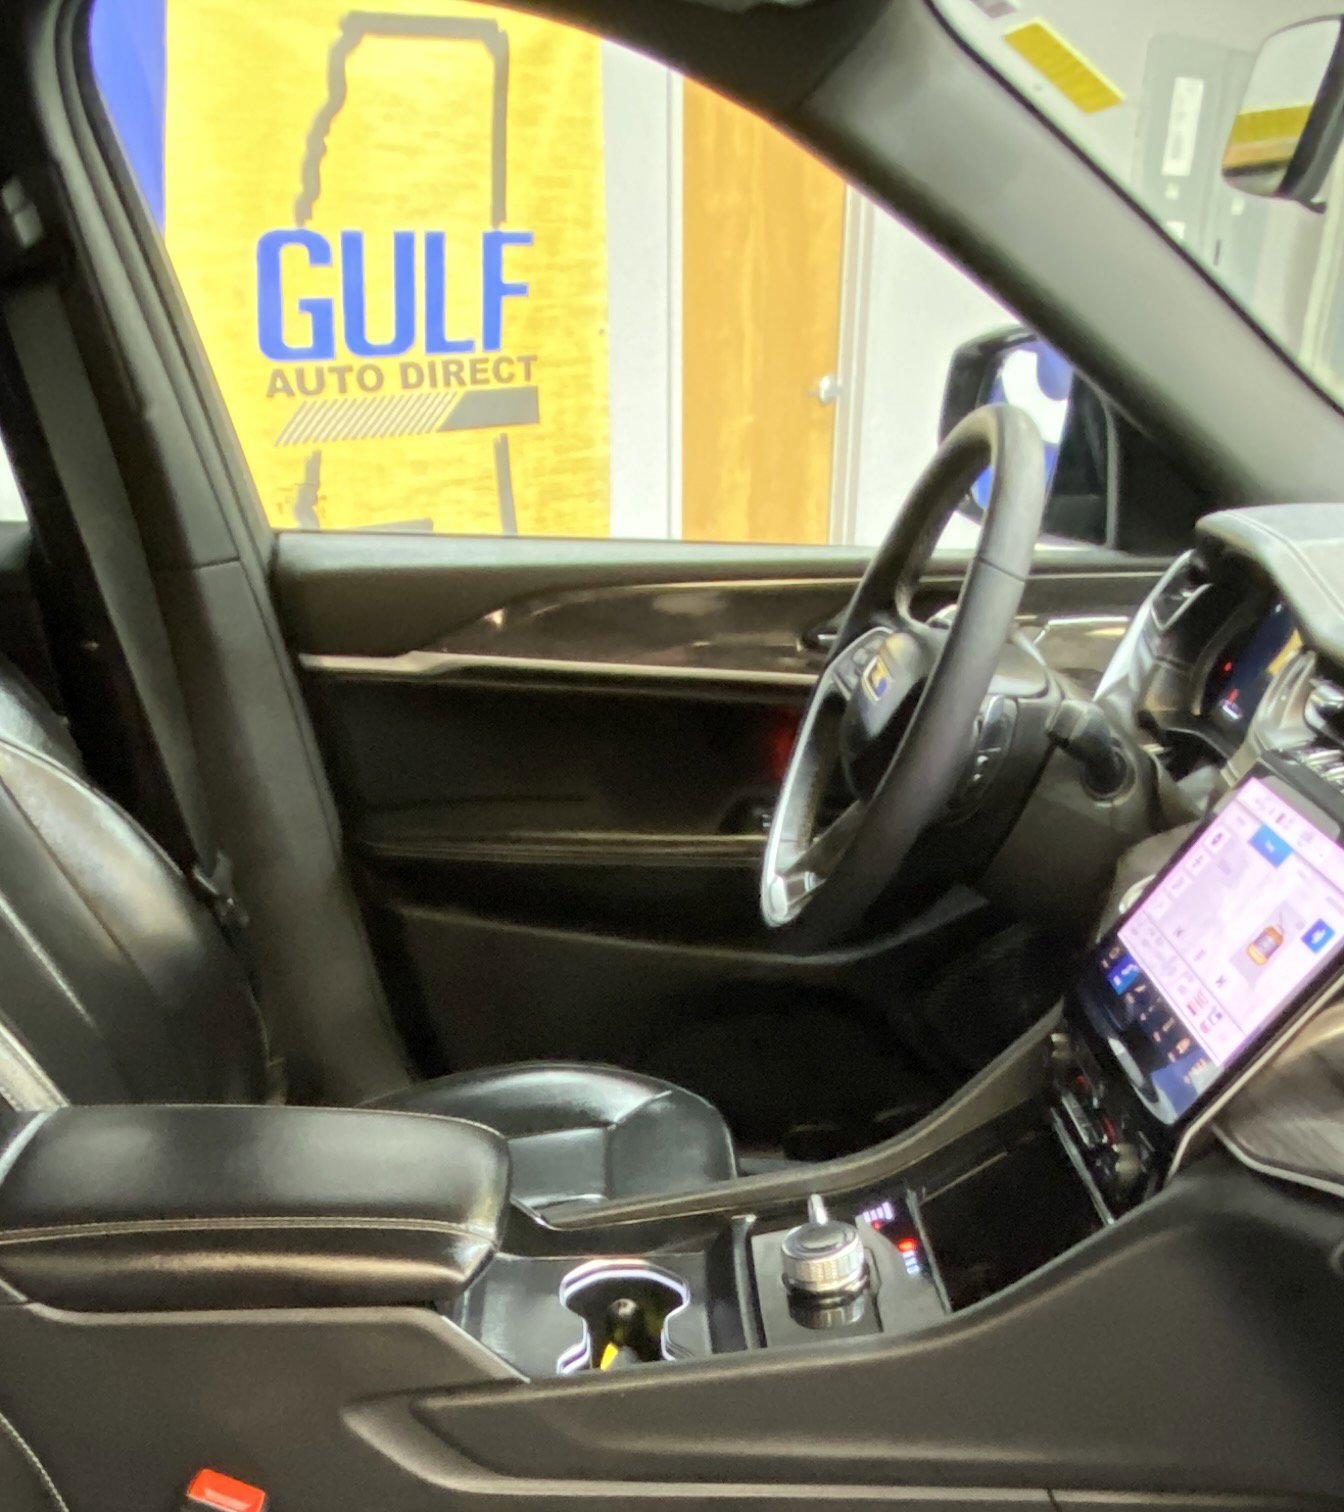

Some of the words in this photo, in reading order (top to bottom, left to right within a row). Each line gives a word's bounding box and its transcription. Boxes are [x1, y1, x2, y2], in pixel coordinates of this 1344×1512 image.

[256, 229, 534, 361] GULF
[266, 364, 385, 399] AUTO
[399, 355, 538, 390] DIRECT
